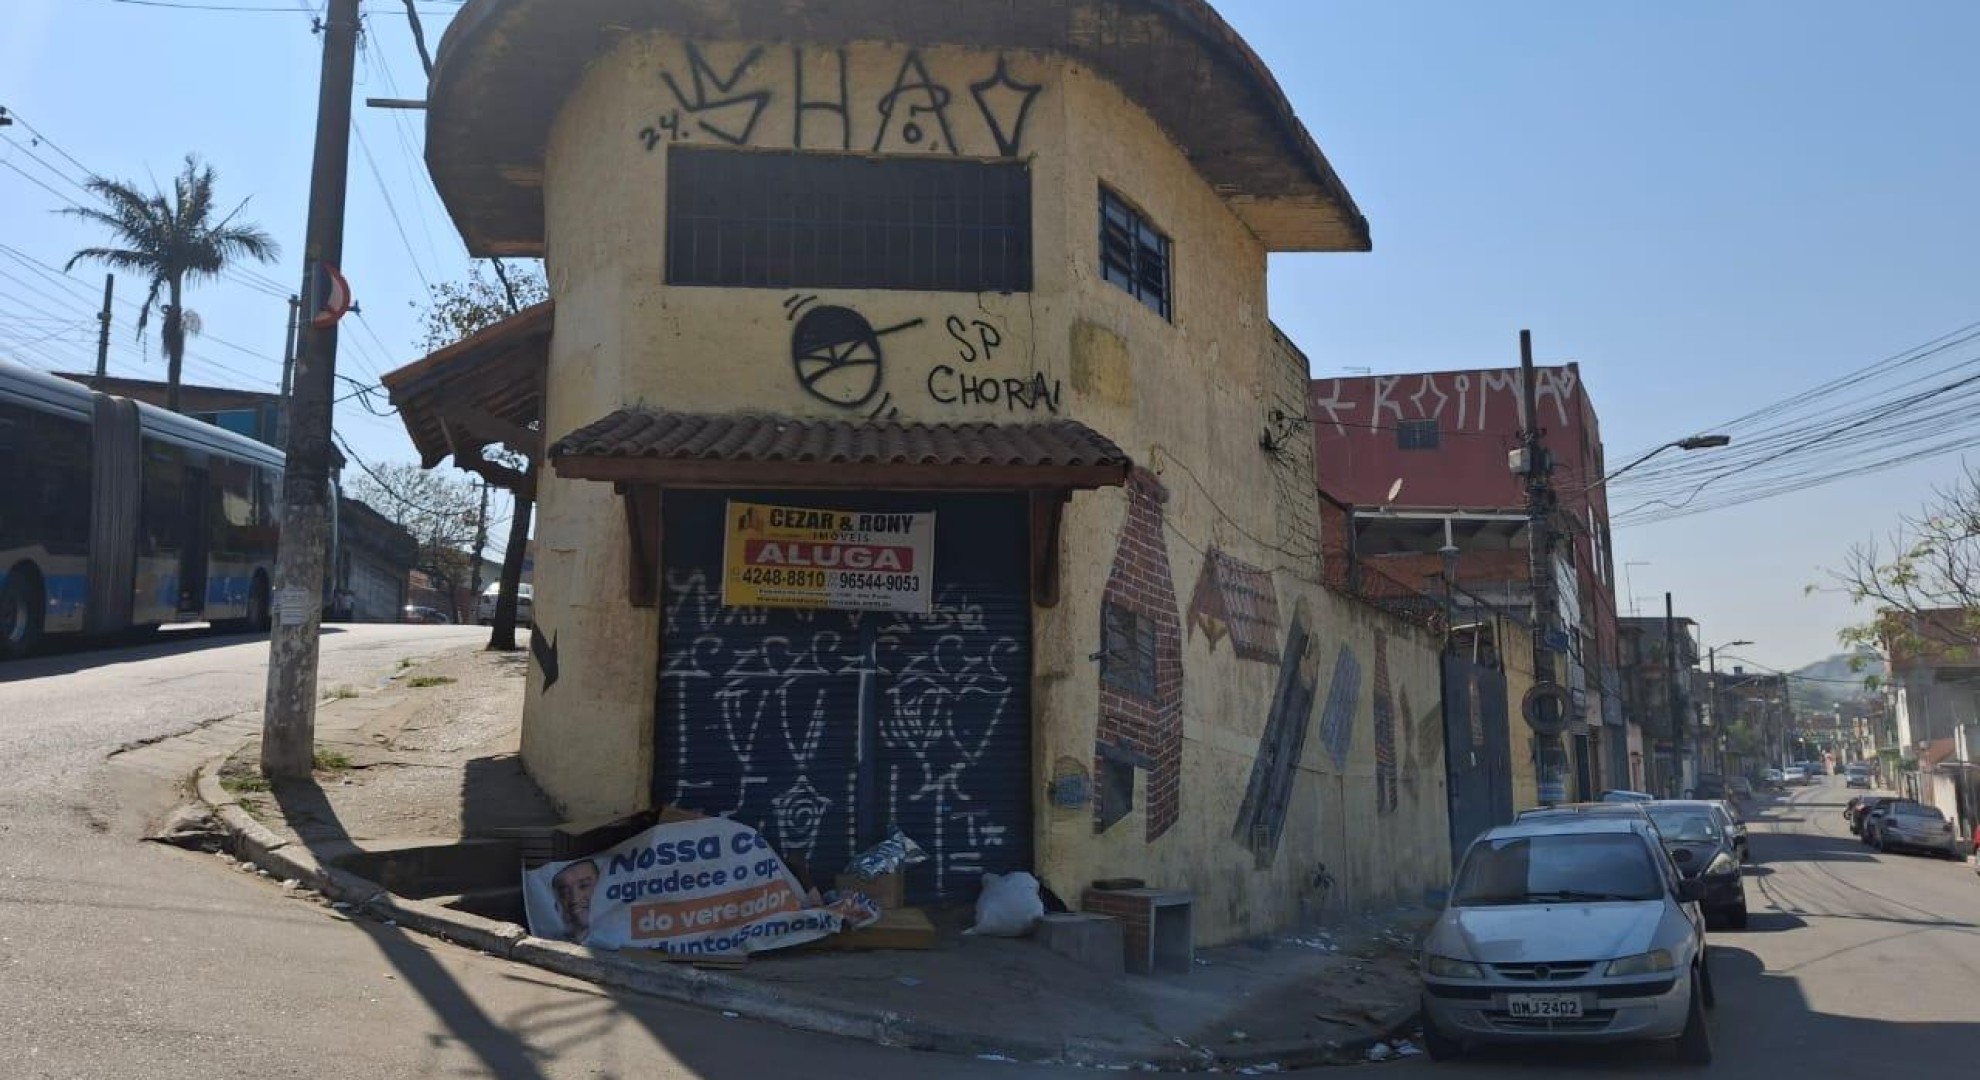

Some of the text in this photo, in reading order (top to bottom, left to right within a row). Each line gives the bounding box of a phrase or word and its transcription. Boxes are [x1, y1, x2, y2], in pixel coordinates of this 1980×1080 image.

[946, 316, 1001, 362] SP
[769, 508, 913, 534] CEZAR & RONY
[755, 542, 901, 569] ALUGA
[742, 567, 920, 592] 4248-8810 96544-9053
[608, 832, 721, 876] Nossa
[606, 870, 727, 904] agradece
[733, 864, 748, 880] o
[638, 888, 791, 934] do vereador
